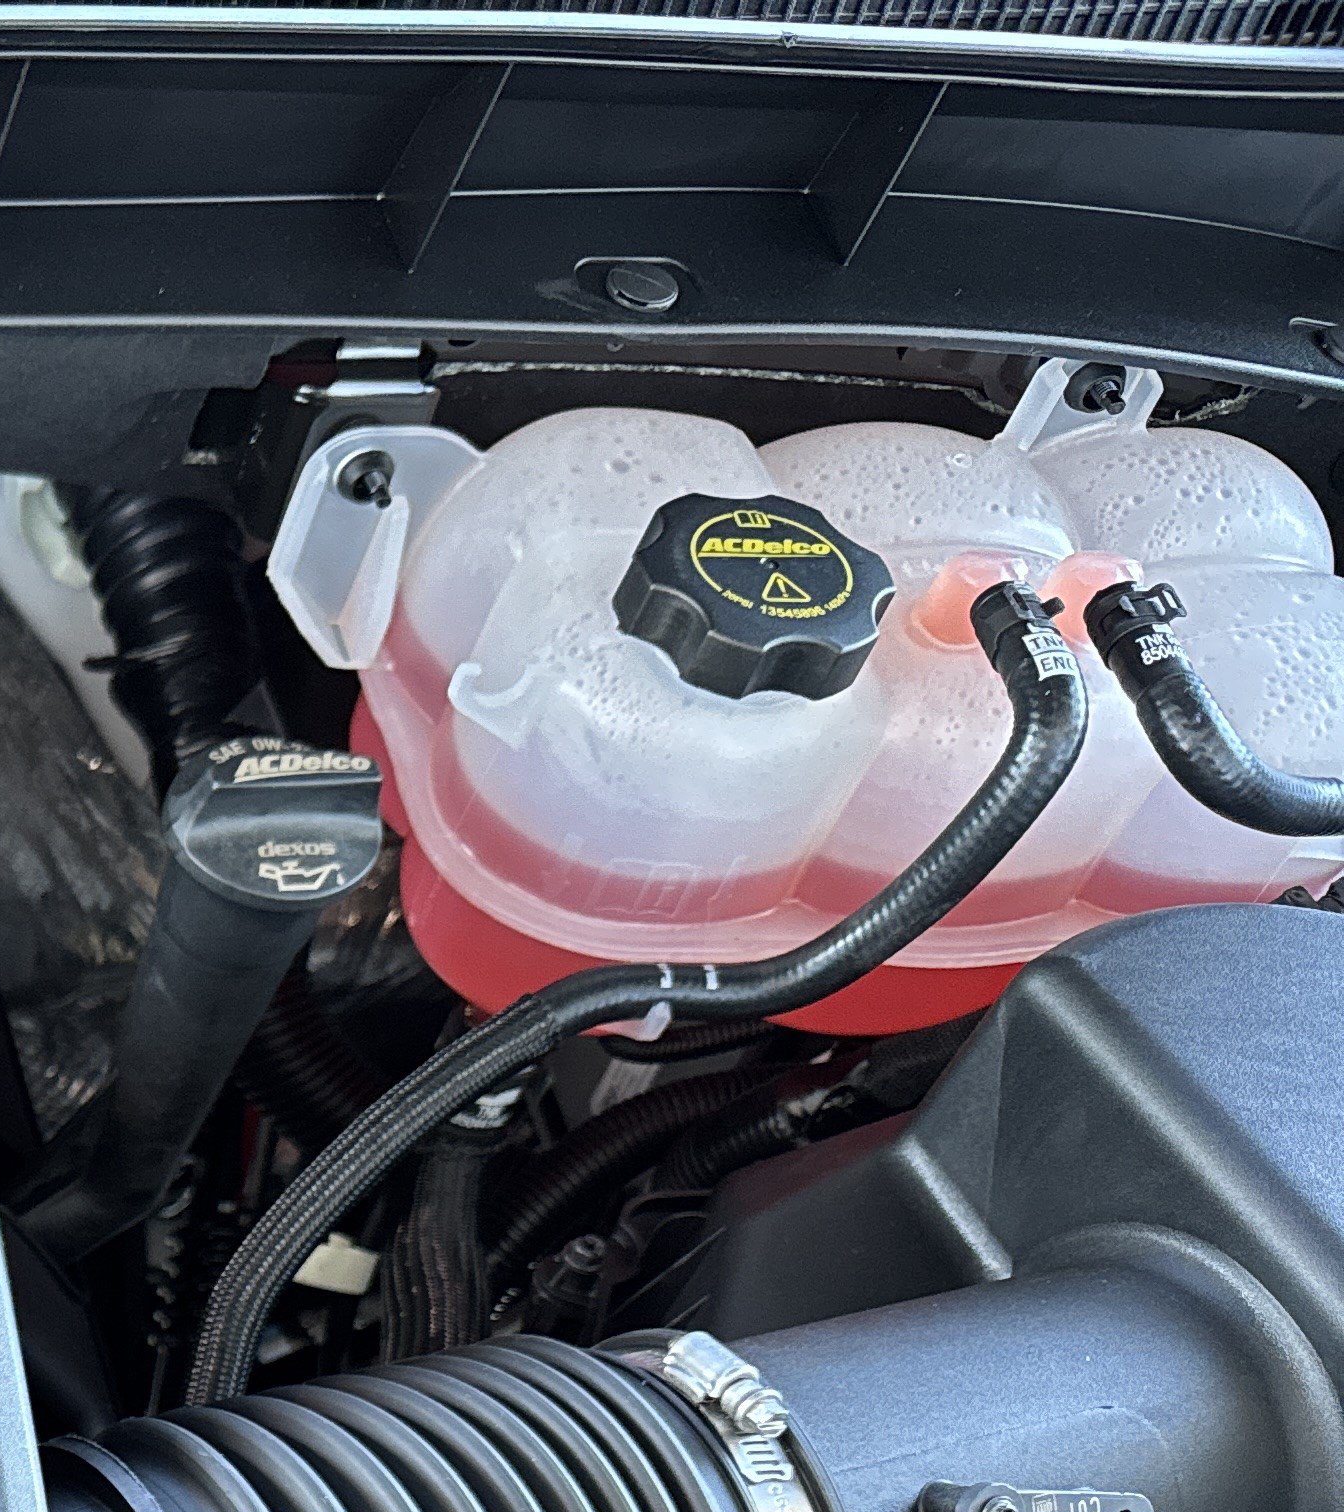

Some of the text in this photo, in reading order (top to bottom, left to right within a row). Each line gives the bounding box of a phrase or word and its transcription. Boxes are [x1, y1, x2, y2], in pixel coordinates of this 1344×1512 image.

[698, 537, 831, 557] ACDelco
[1135, 633, 1167, 651] TNK
[208, 737, 247, 764] SAE
[233, 751, 372, 783] ACDelco
[257, 841, 336, 857] dexos
